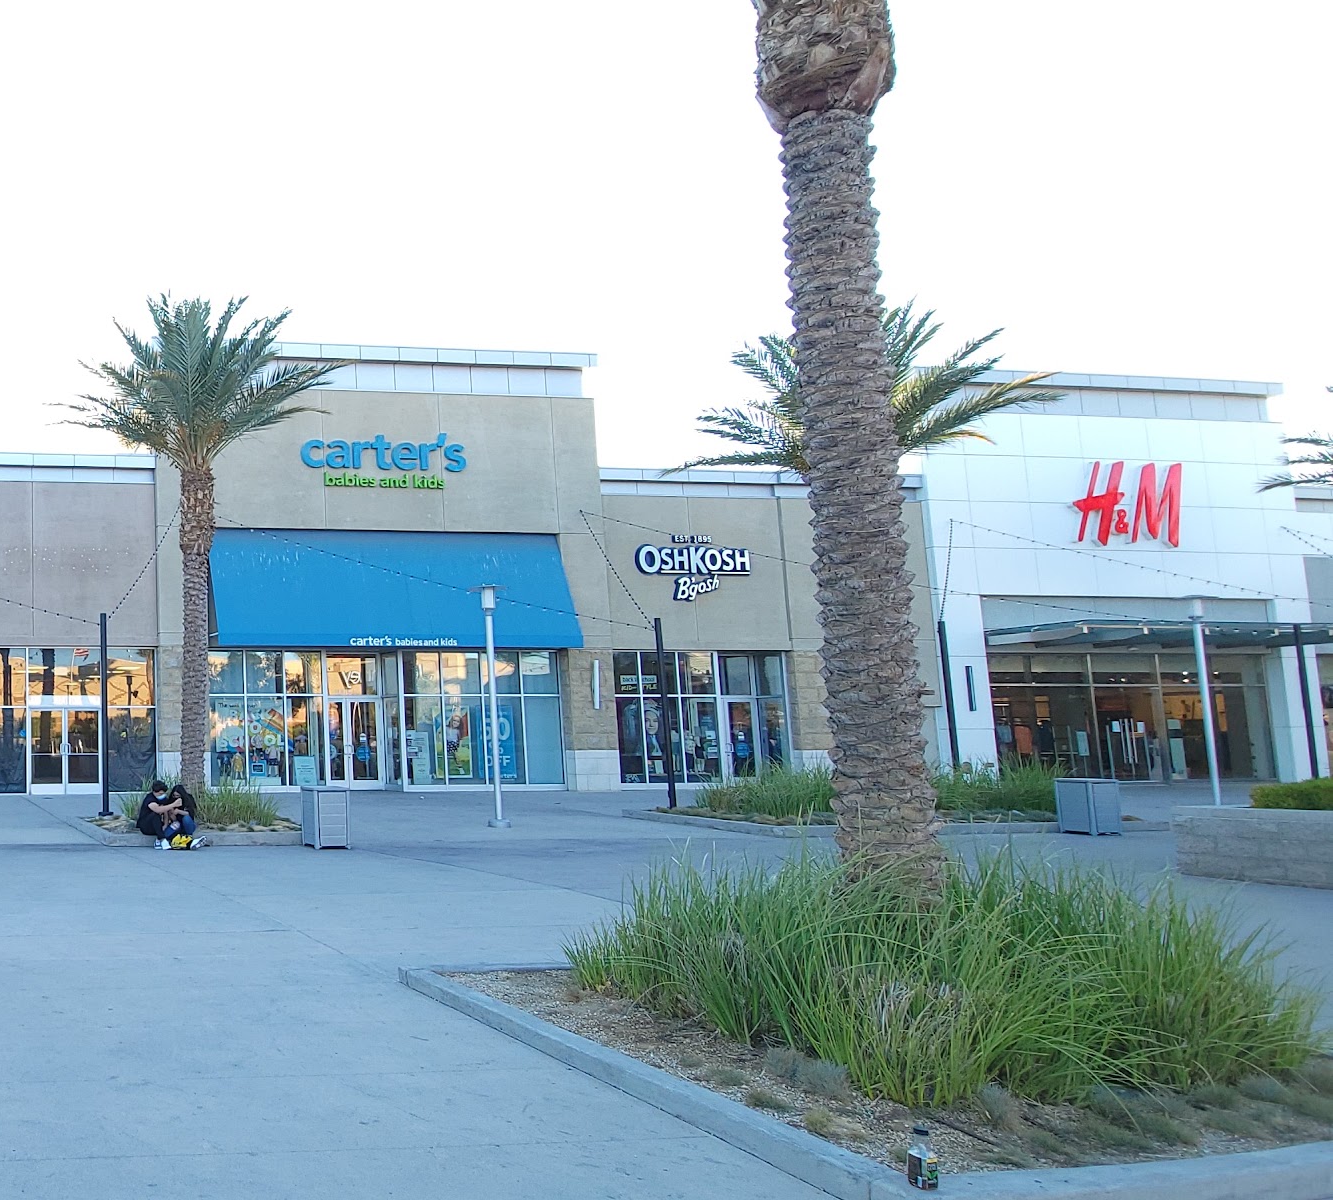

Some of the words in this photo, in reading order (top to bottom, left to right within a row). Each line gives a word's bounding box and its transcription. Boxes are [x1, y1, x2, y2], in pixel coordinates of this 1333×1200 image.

[300, 432, 467, 472] carter's
[324, 472, 377, 488] babies
[379, 474, 409, 489] and
[413, 474, 446, 489] kids
[1071, 460, 1182, 548] H&M
[693, 535, 712, 543] 1895
[638, 545, 751, 574] OSHKOSH
[676, 574, 720, 601] B'gosh
[350, 635, 393, 646] carter's
[395, 638, 423, 646] babies
[423, 638, 439, 646] and
[440, 638, 458, 646] kids
